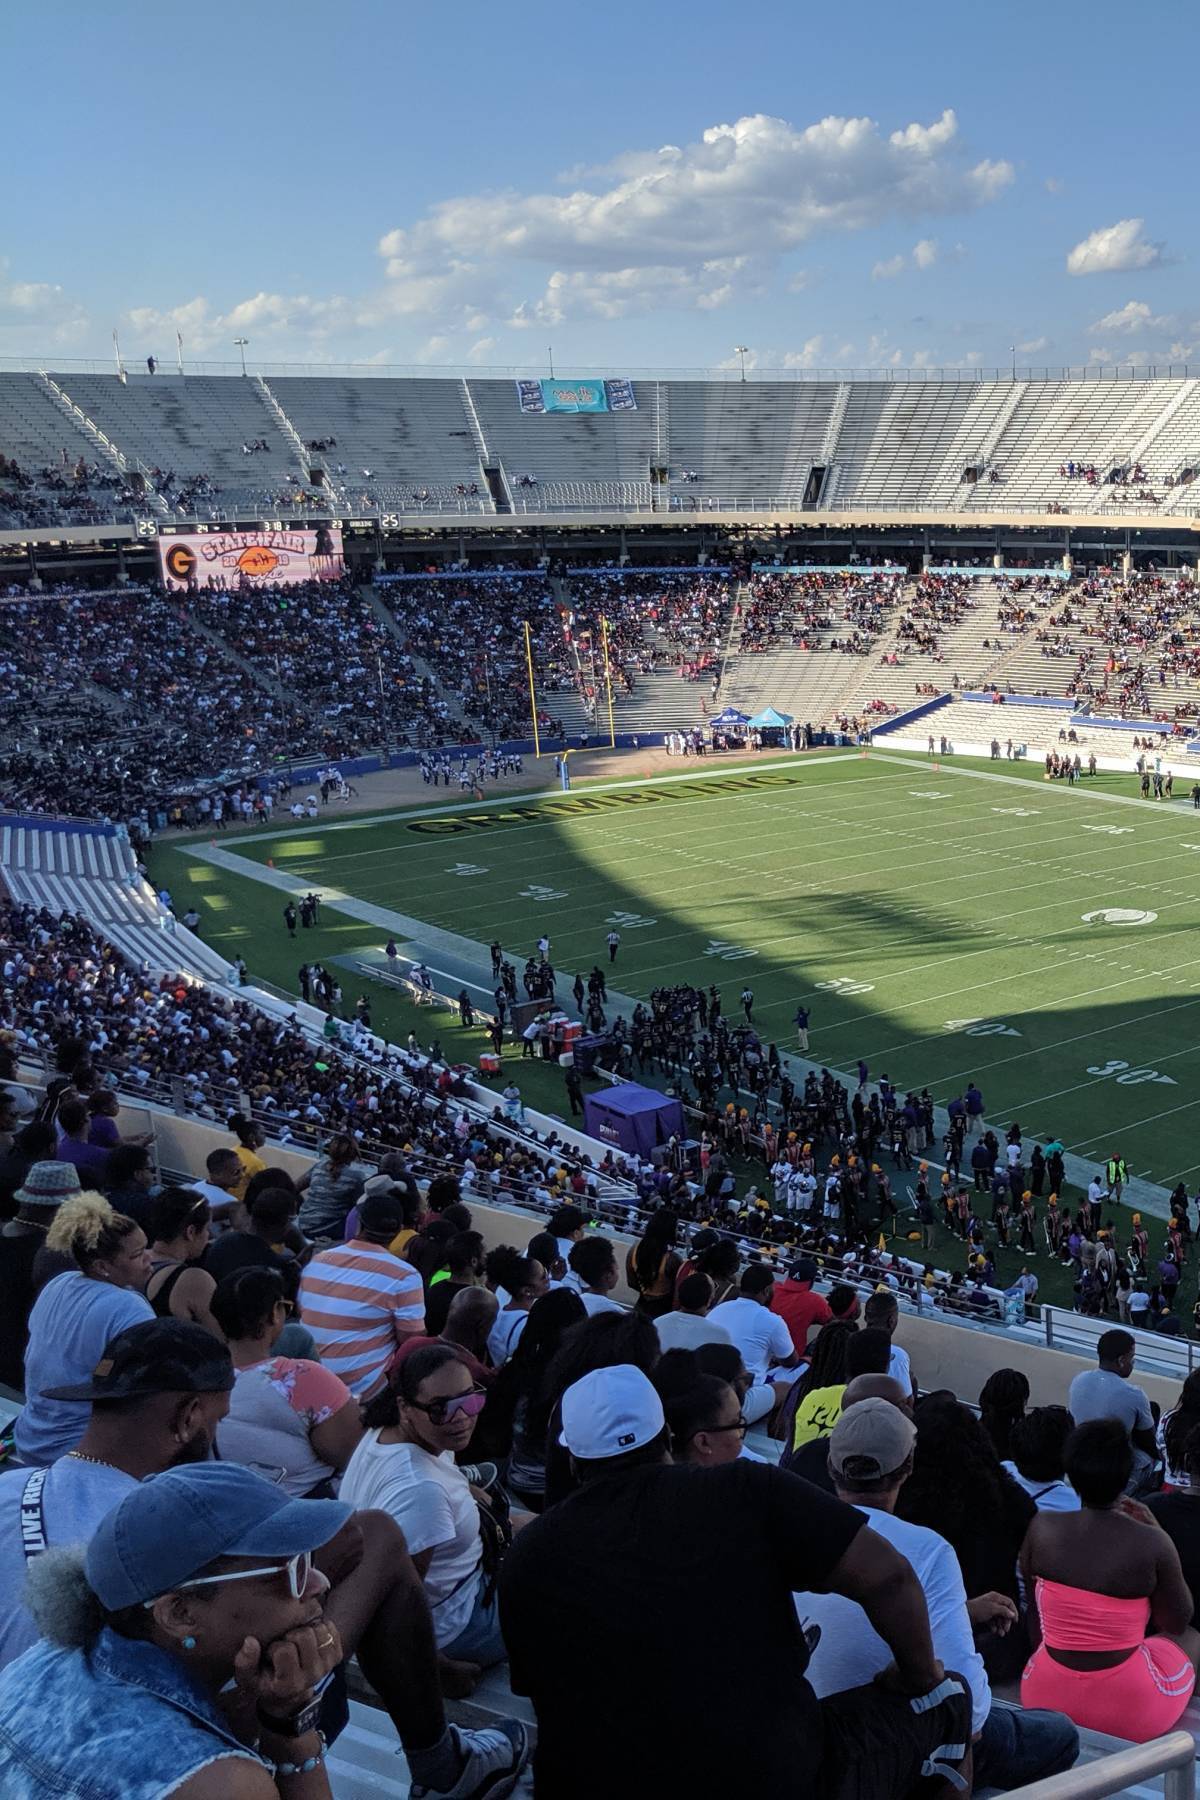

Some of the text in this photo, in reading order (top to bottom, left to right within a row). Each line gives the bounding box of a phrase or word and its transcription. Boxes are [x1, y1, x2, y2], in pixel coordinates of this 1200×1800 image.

[139, 521, 156, 535] 25
[197, 525, 208, 533] 24
[332, 520, 343, 529] 23
[382, 514, 398, 527] 25
[200, 532, 305, 561] STATE FAIR
[406, 775, 801, 834] GRAMBLING
[813, 977, 876, 996] 50
[941, 1017, 1007, 1037] 40
[1086, 1060, 1158, 1085] 30
[22, 1506, 46, 1551] LIVE
